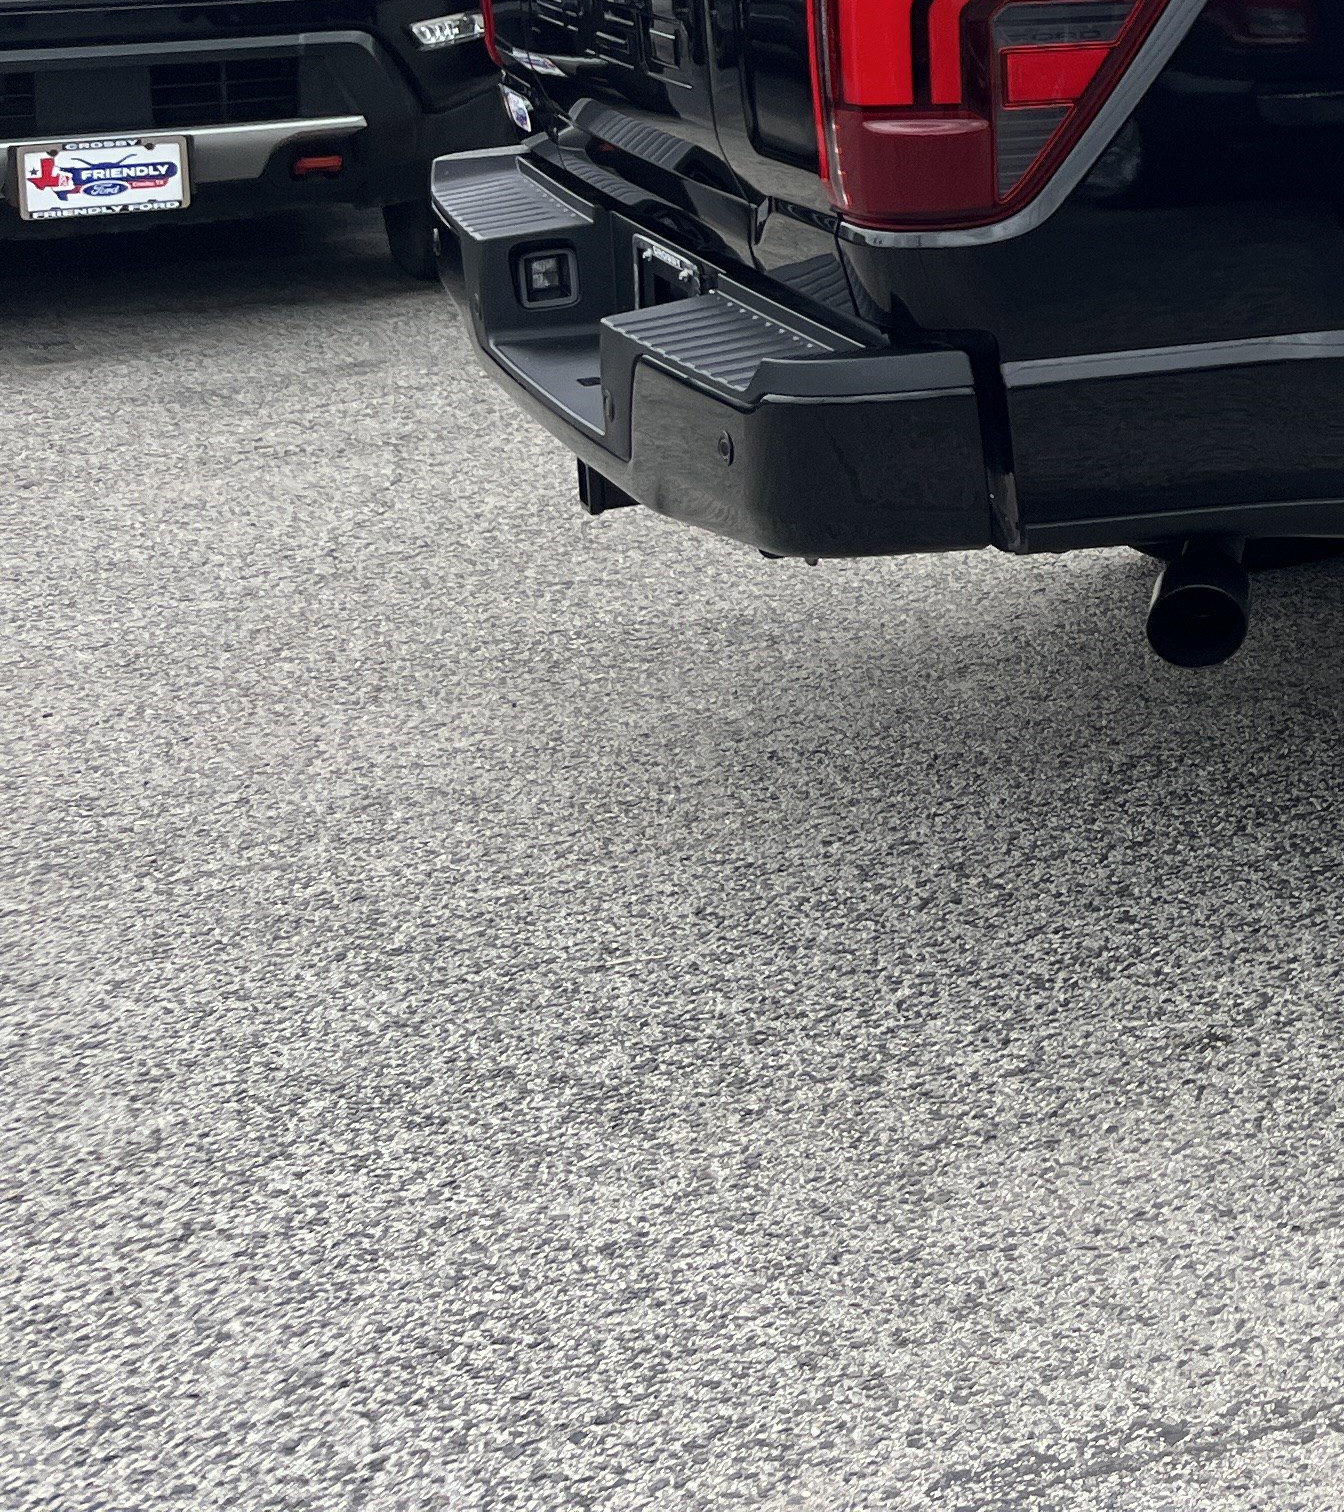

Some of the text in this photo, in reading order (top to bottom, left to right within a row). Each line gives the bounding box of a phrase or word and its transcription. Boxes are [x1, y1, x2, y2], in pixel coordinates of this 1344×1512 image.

[65, 139, 139, 150] CROSBY
[81, 164, 169, 181] FRIENDLY
[90, 183, 119, 196] Ford
[32, 201, 180, 219] FRIENDLY FORD
